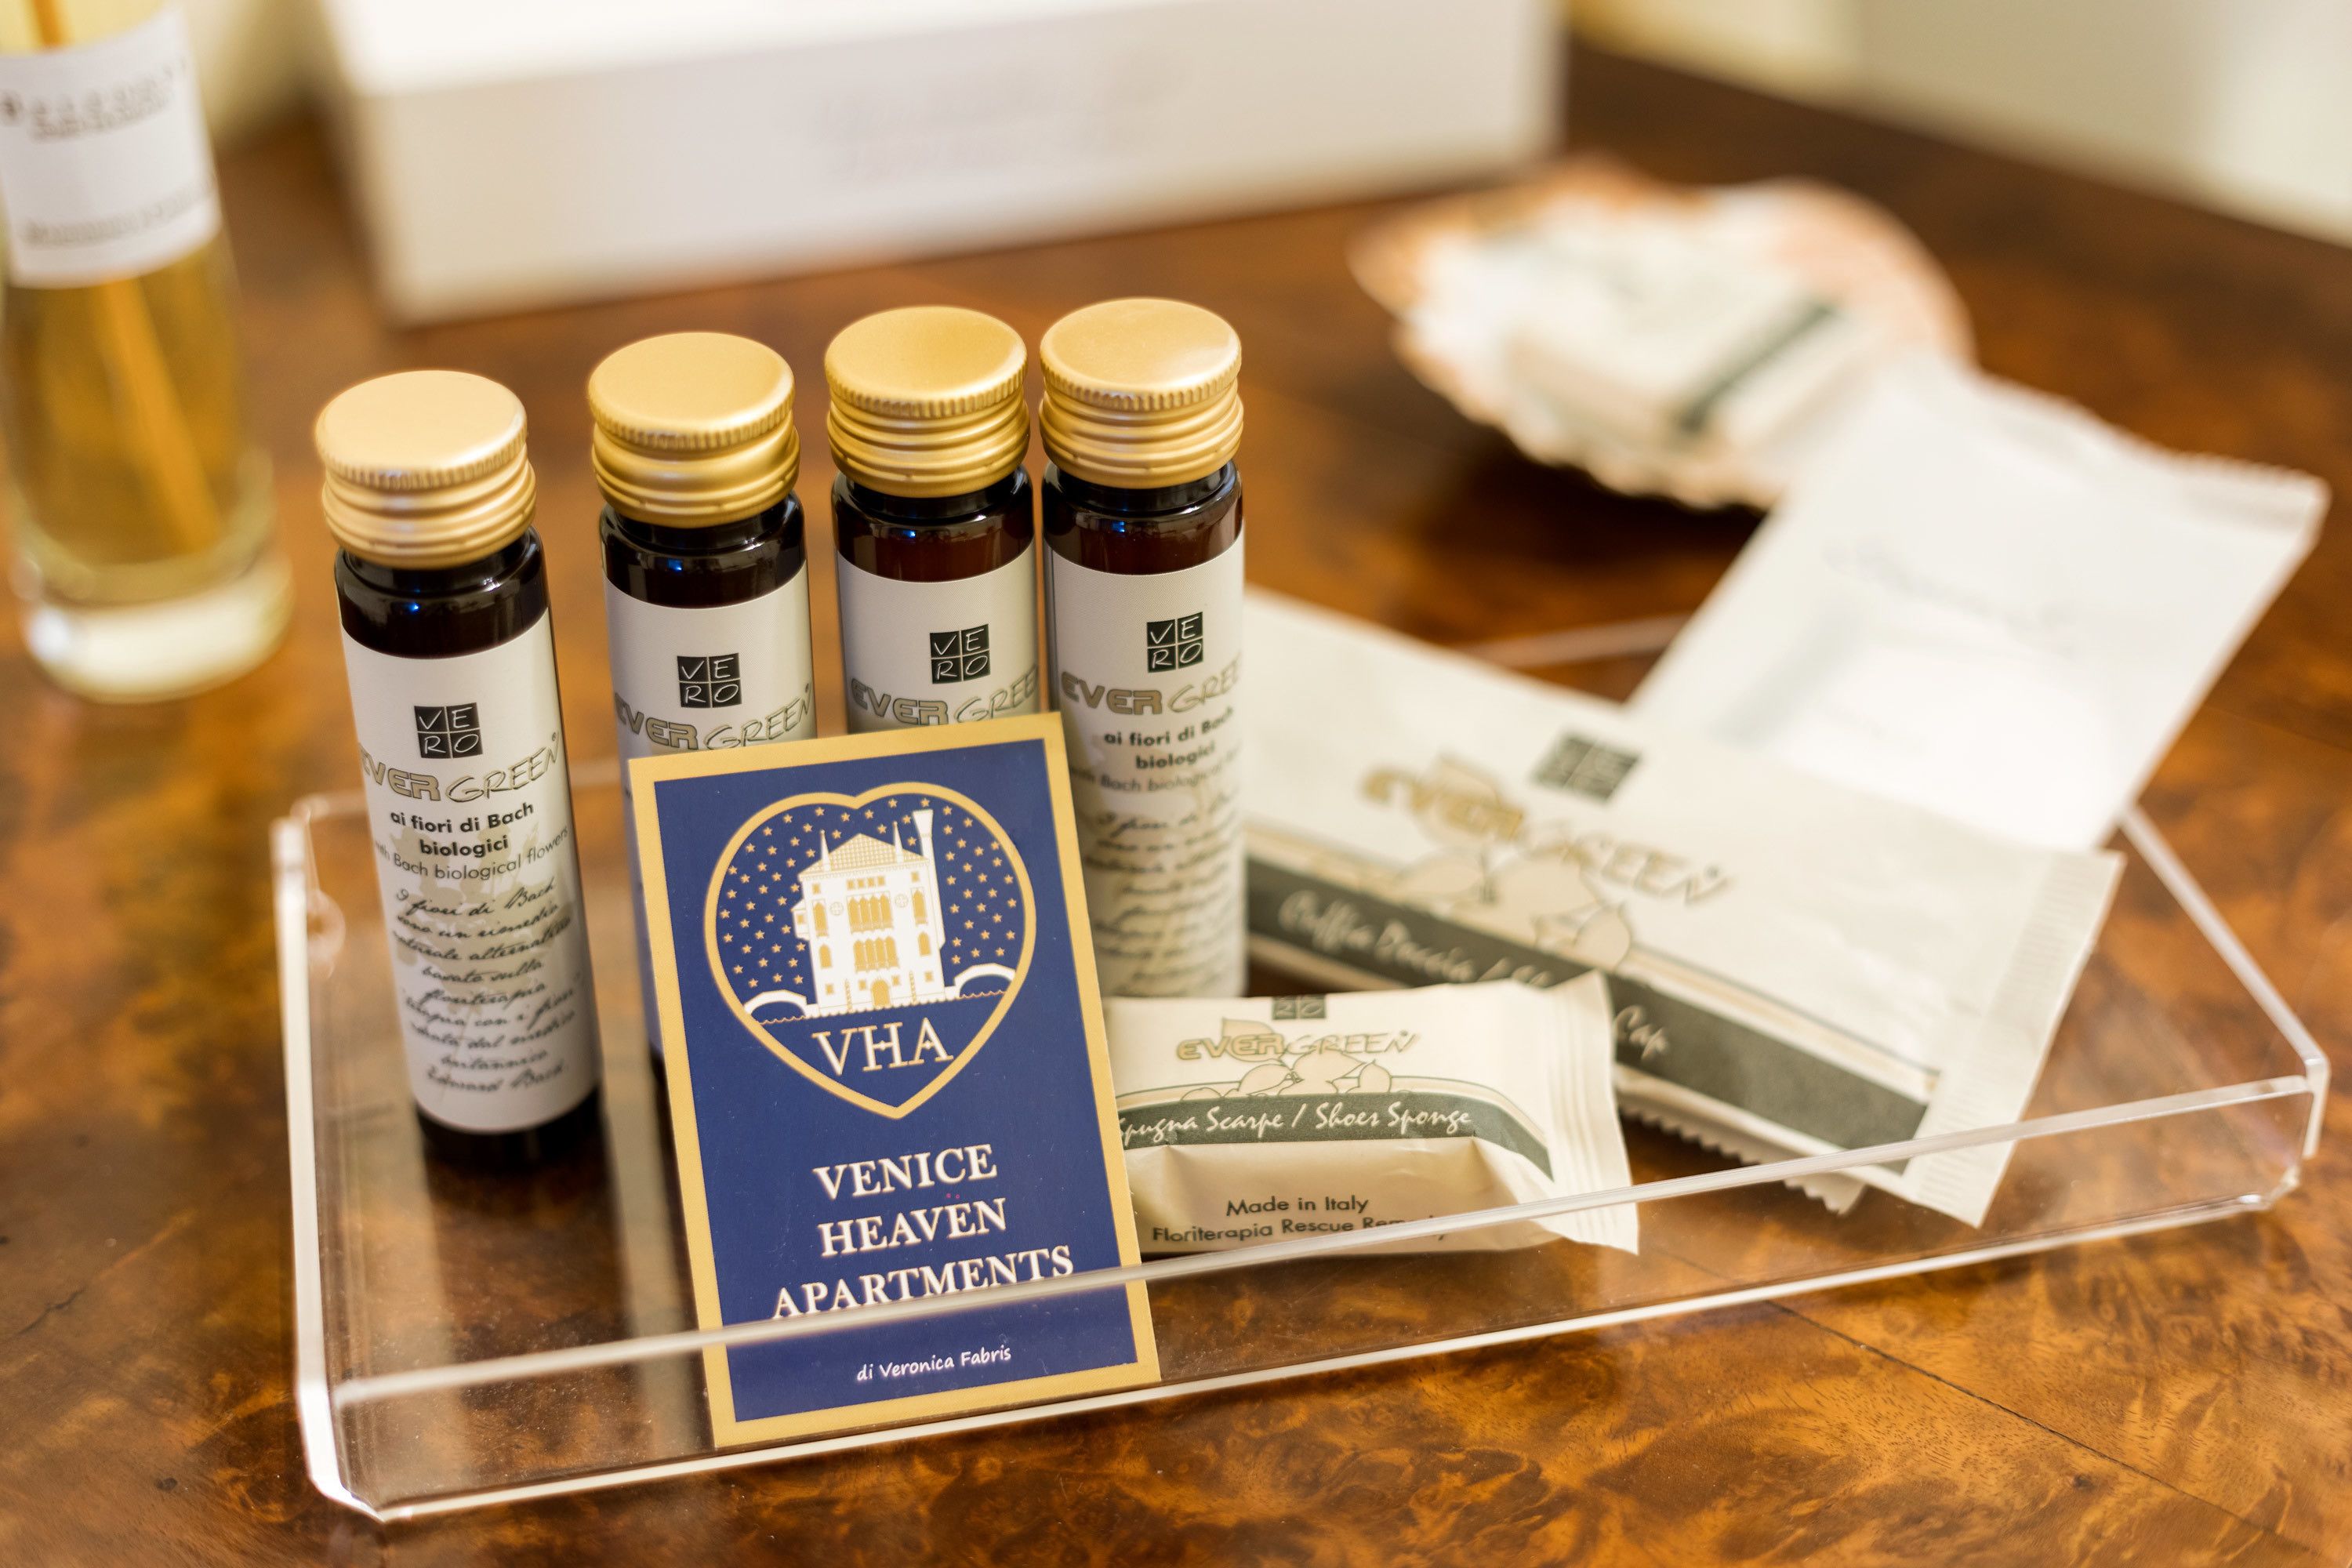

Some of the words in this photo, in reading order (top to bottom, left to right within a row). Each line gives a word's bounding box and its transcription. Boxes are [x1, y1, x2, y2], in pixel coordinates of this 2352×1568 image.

[1104, 731, 1122, 745] ai
[1130, 731, 1171, 746] fiori
[1178, 726, 1195, 742] di
[1136, 742, 1215, 769] biologici
[390, 811, 406, 824] ai
[411, 815, 452, 833] fiori
[460, 818, 481, 833] di
[487, 802, 535, 829] Bach
[394, 851, 428, 877] Bach
[434, 854, 522, 880] biological
[526, 826, 569, 862] flowers
[419, 835, 509, 858] biologici
[811, 1017, 954, 1075] VHA
[1206, 1105, 1284, 1138] Scarpe
[1315, 1101, 1381, 1130] Shoes
[1387, 1101, 1473, 1135] Sponge
[813, 1143, 998, 1201] VENICE
[1225, 1196, 1290, 1217] Made
[1298, 1197, 1316, 1211] in
[1325, 1194, 1370, 1214] Italy
[817, 1197, 1007, 1258] HEAVEN
[1152, 1222, 1273, 1243] Floriterapia
[1282, 1218, 1354, 1235] Rescue
[772, 1244, 1076, 1319] APARTMENTS
[856, 1363, 874, 1381] di
[879, 1354, 955, 1377] Veronica
[960, 1344, 1012, 1367] Fabris
